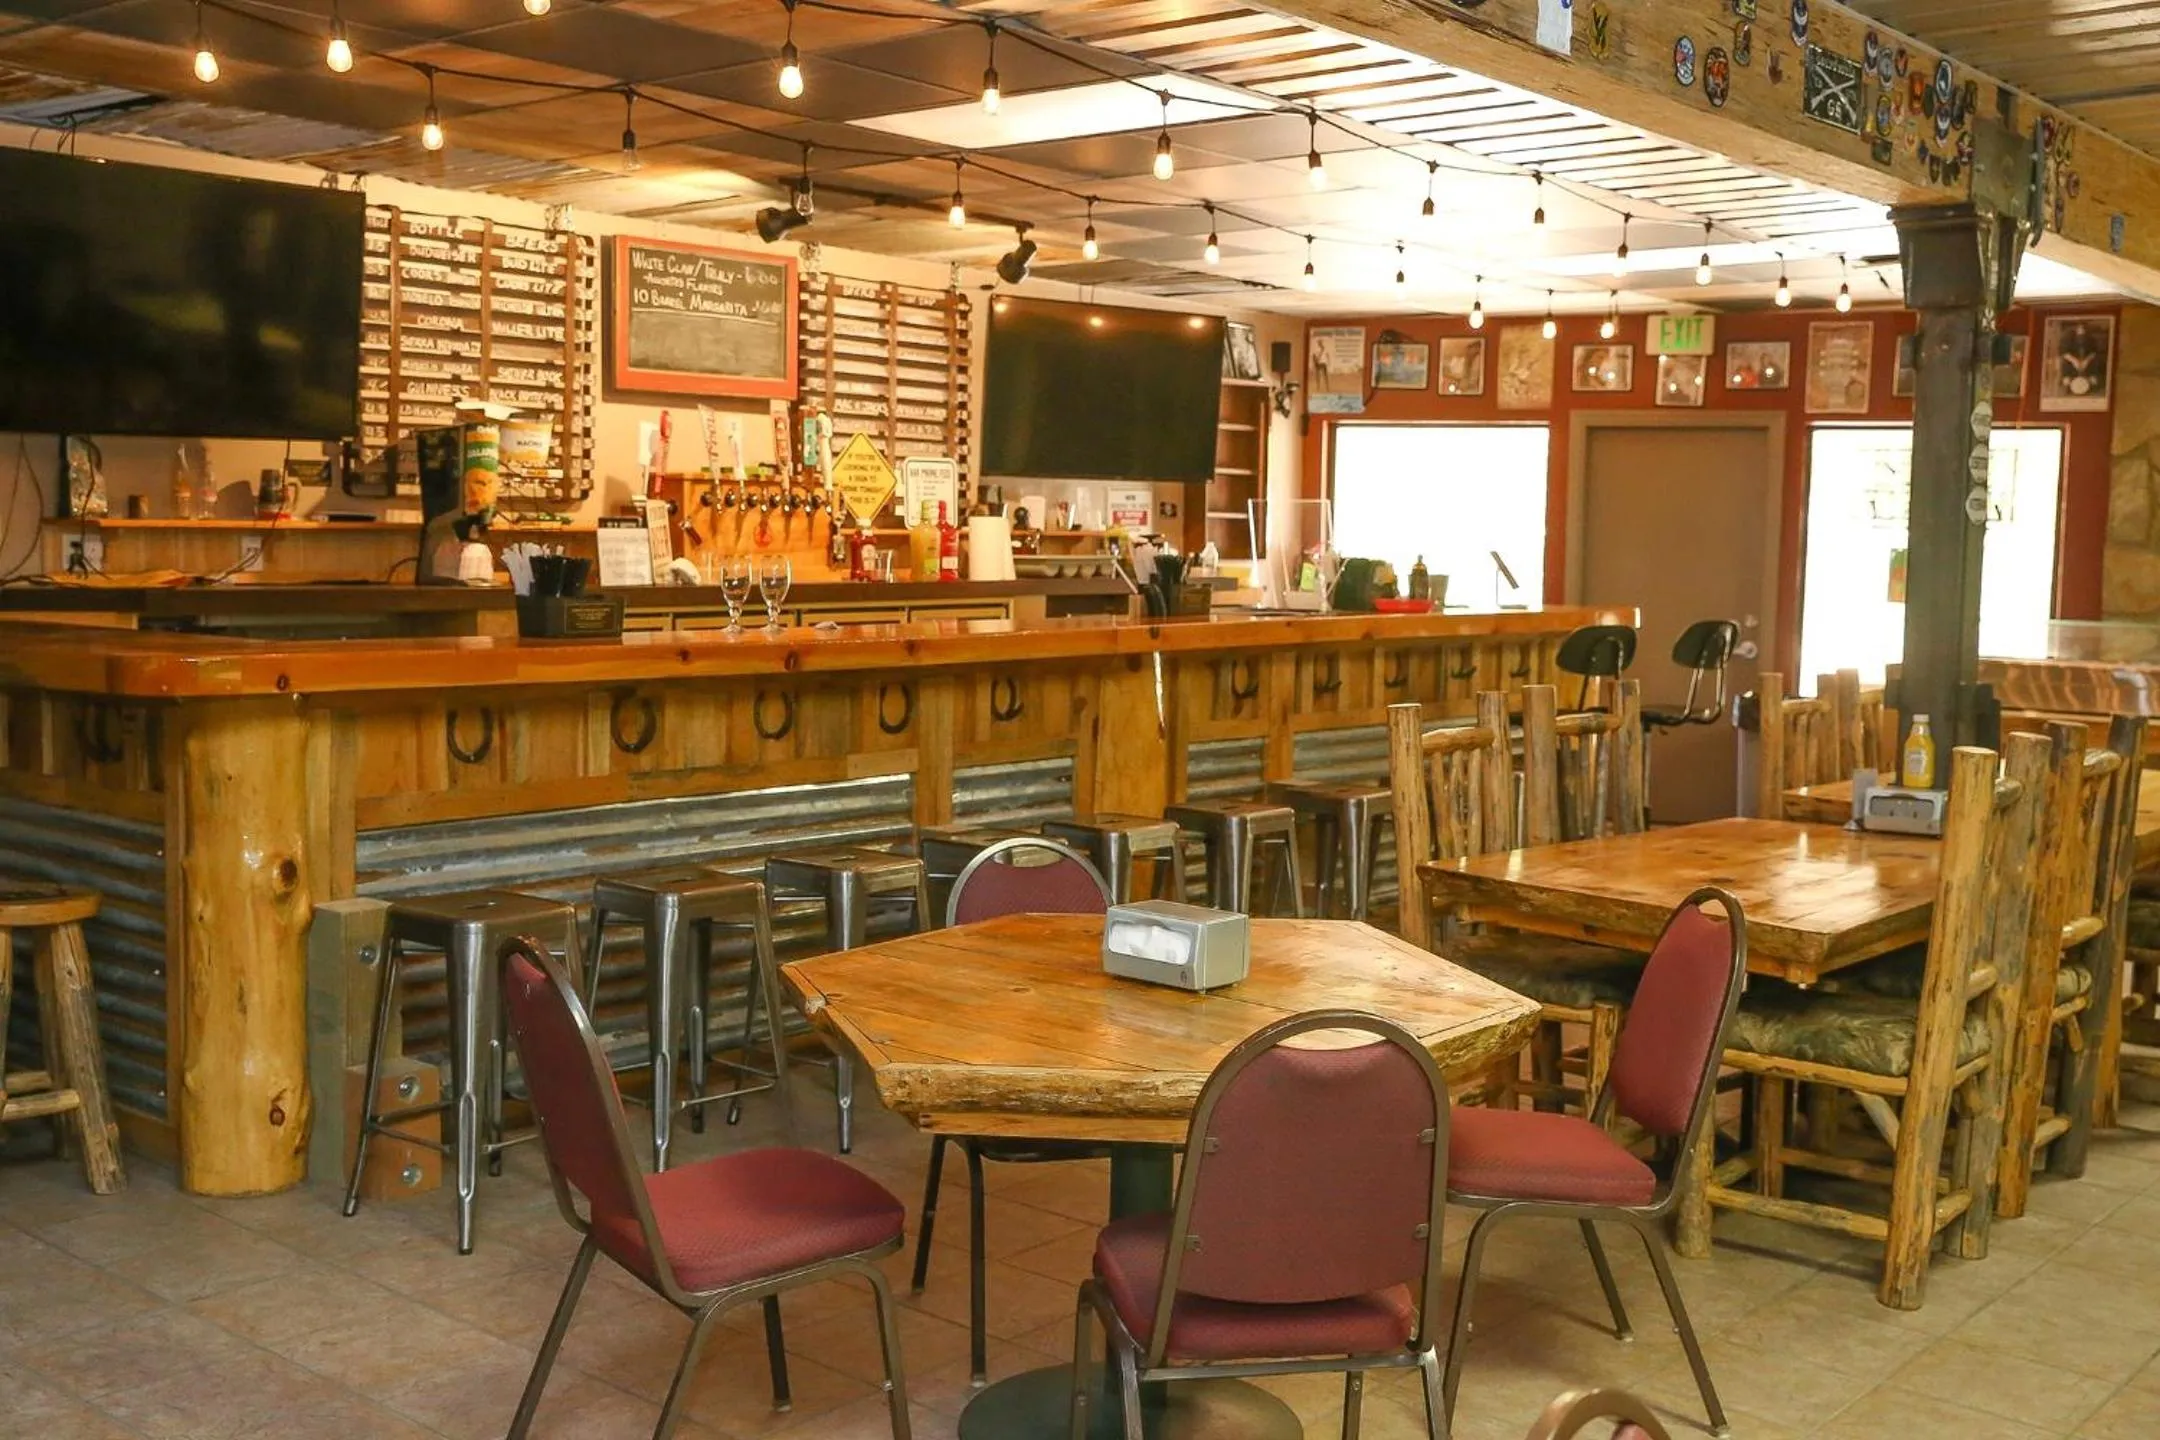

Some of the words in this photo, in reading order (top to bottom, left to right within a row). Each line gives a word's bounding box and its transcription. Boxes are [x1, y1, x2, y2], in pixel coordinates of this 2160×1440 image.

[408, 221, 465, 239] BOTTLE
[504, 234, 560, 253] BEERS
[416, 314, 465, 331] CORONA
[1659, 317, 1704, 350] EXIT
[406, 380, 471, 398] GUINNESS
